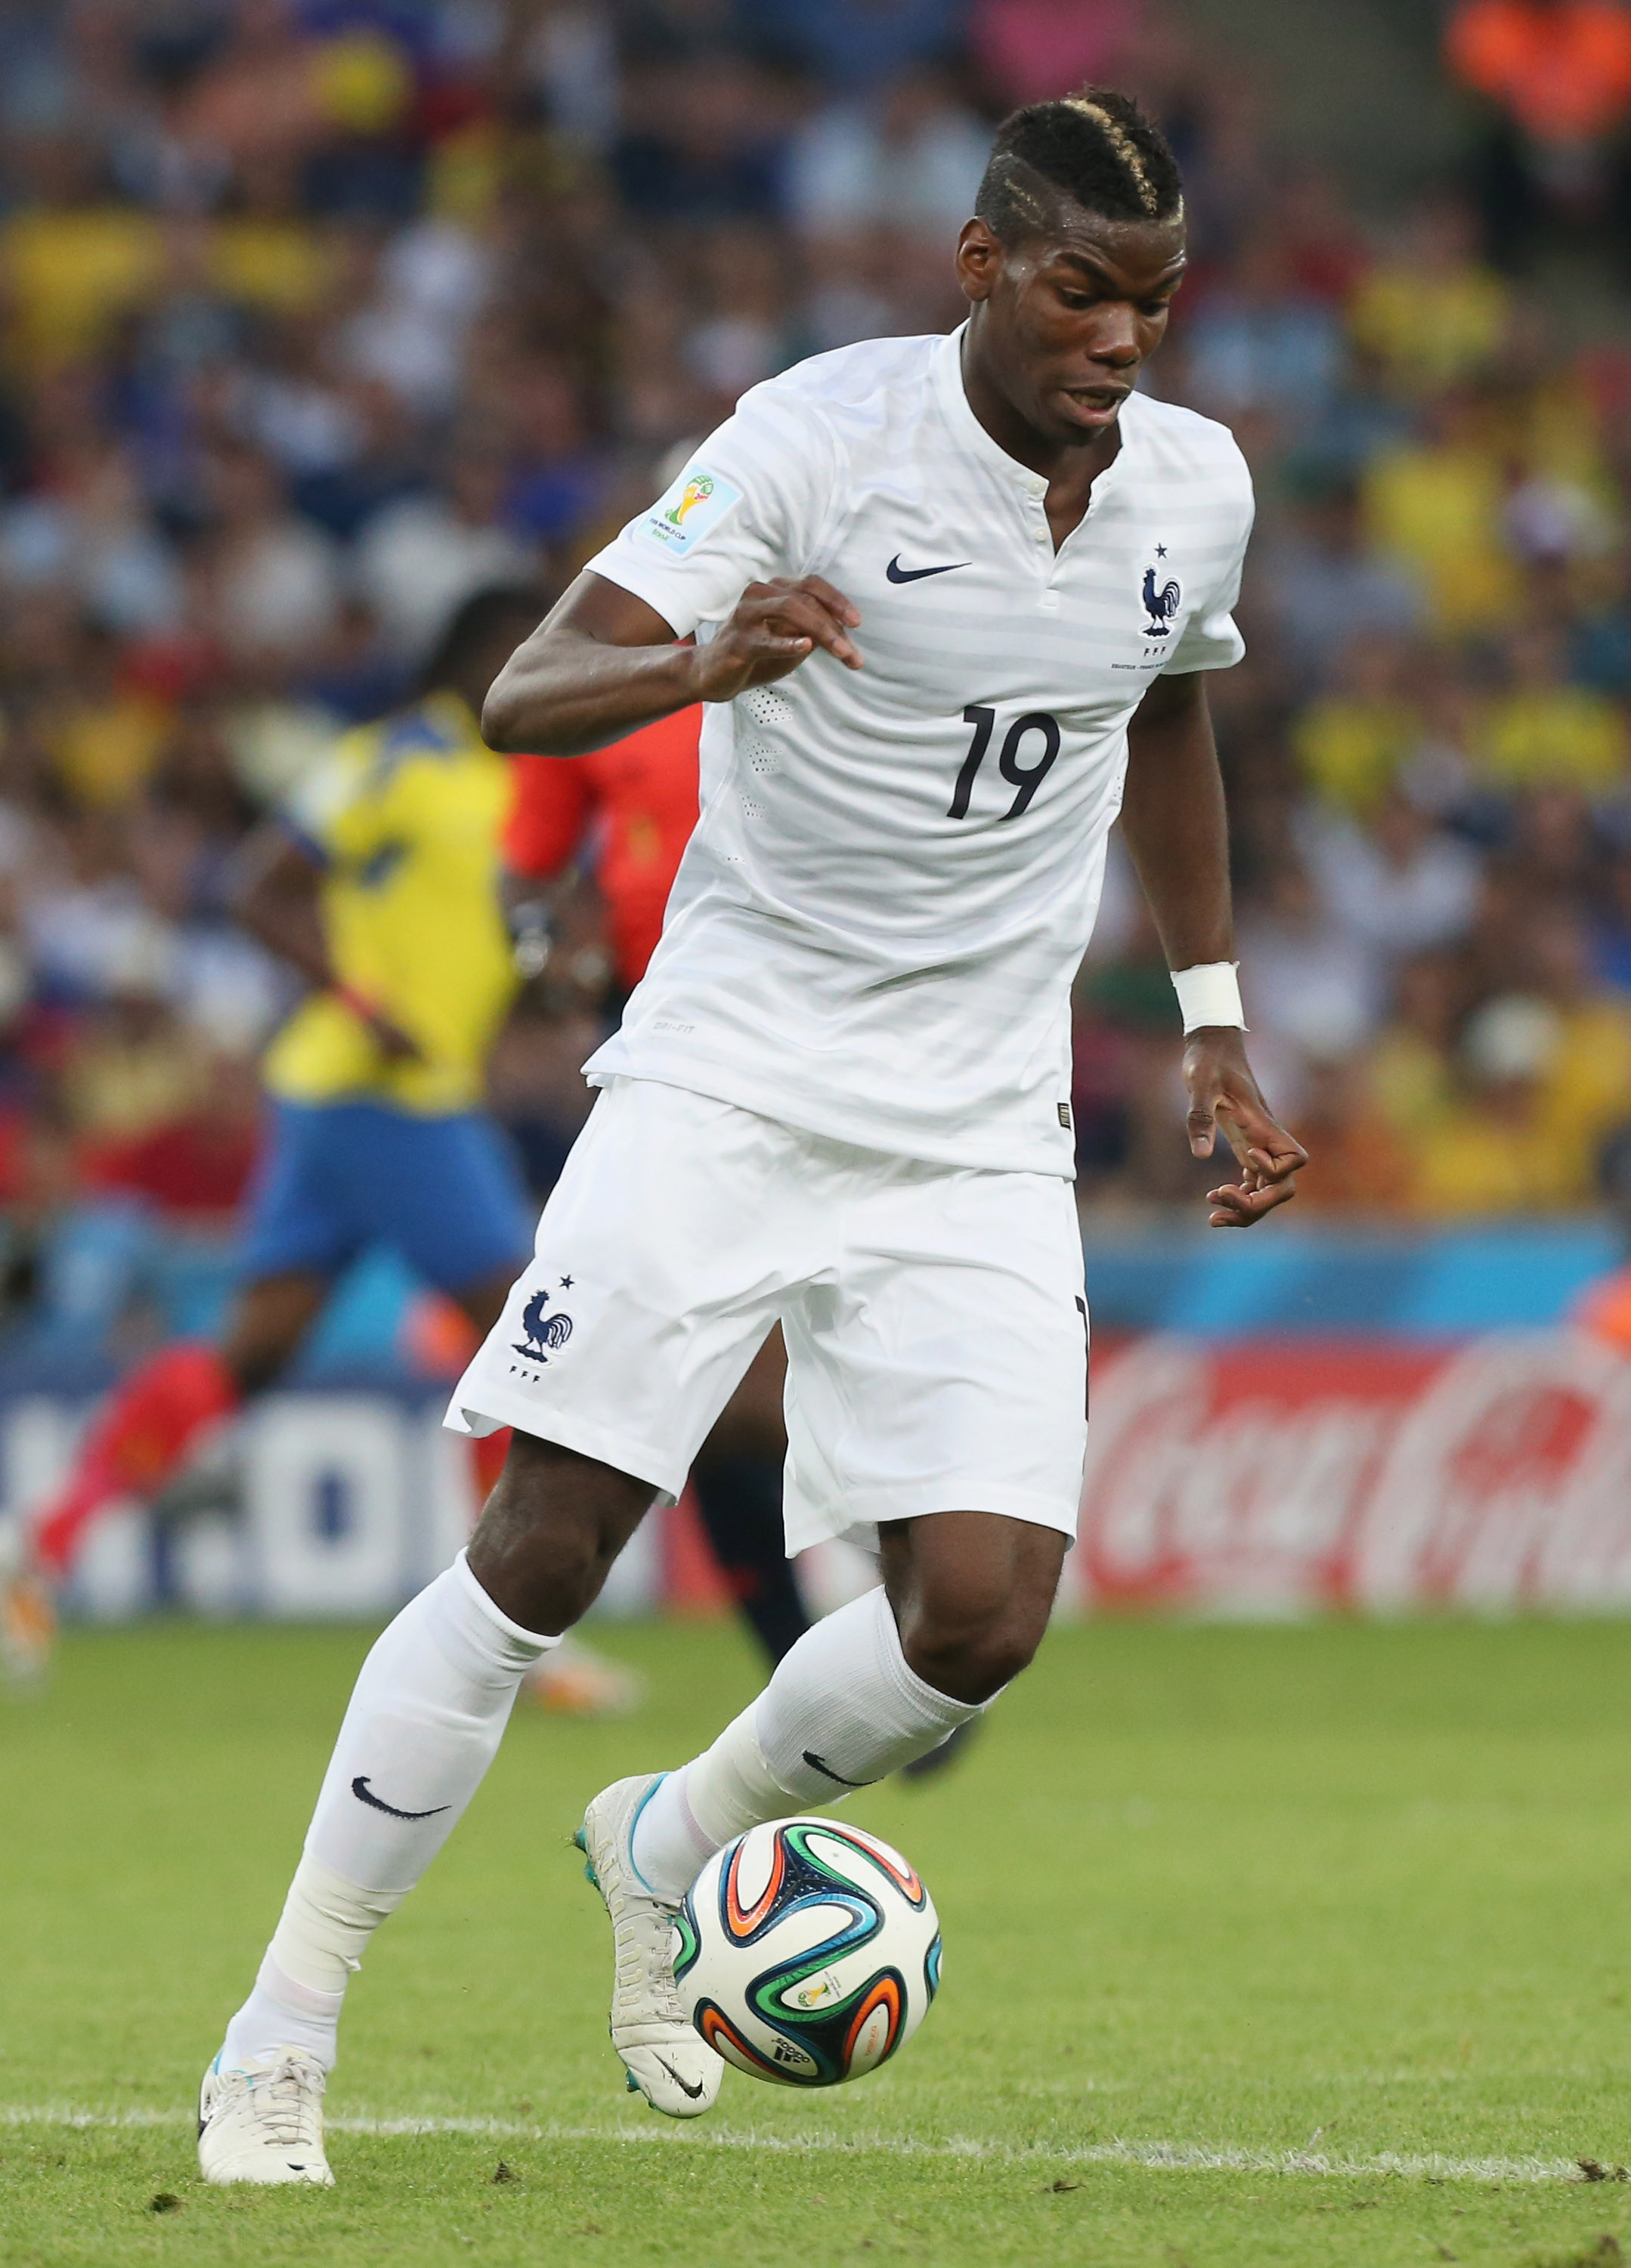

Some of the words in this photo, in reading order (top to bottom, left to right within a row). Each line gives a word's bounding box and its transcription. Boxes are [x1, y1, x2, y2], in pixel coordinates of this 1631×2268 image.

[658, 522, 676, 534] WORLD
[674, 531, 686, 540] CUP
[946, 705, 1060, 822] 19
[772, 2037, 809, 2063] adidas
